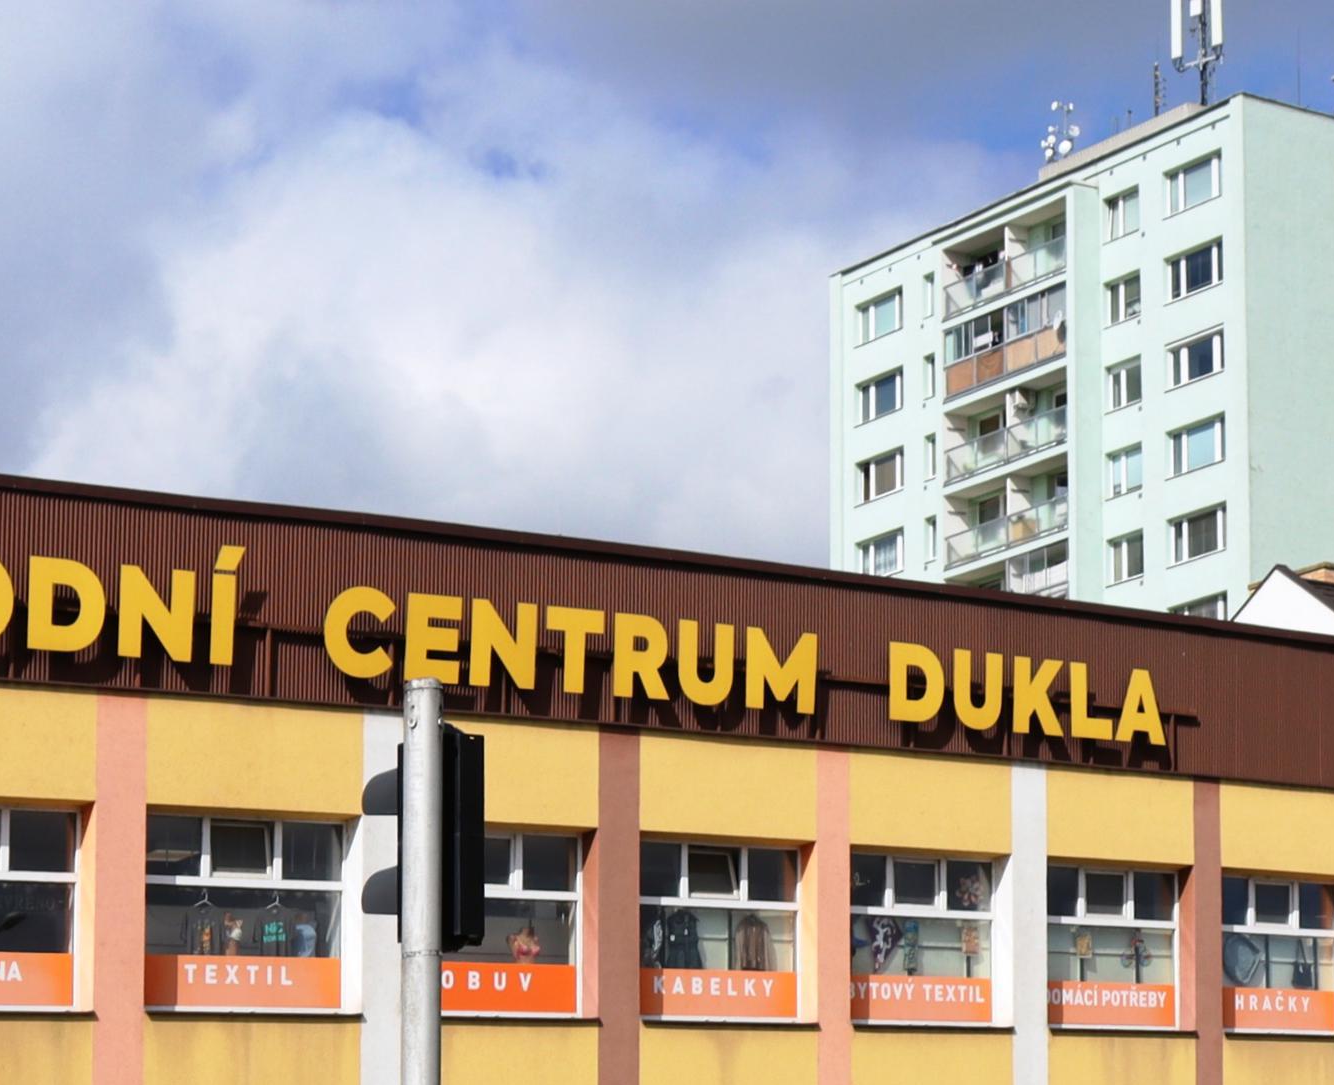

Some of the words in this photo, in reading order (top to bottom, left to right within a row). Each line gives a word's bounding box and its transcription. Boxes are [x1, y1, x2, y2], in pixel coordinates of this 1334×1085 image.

[323, 585, 819, 715] CENTRUM
[889, 641, 1166, 747] DUKLA
[184, 964, 293, 985] TEXTIL
[441, 970, 532, 992] OBUV
[654, 975, 774, 997] KABELKY
[922, 984, 985, 1003] TEXTIL
[1102, 985, 1167, 1008] POTŘEBY
[1235, 991, 1311, 1013] HRAČKY
